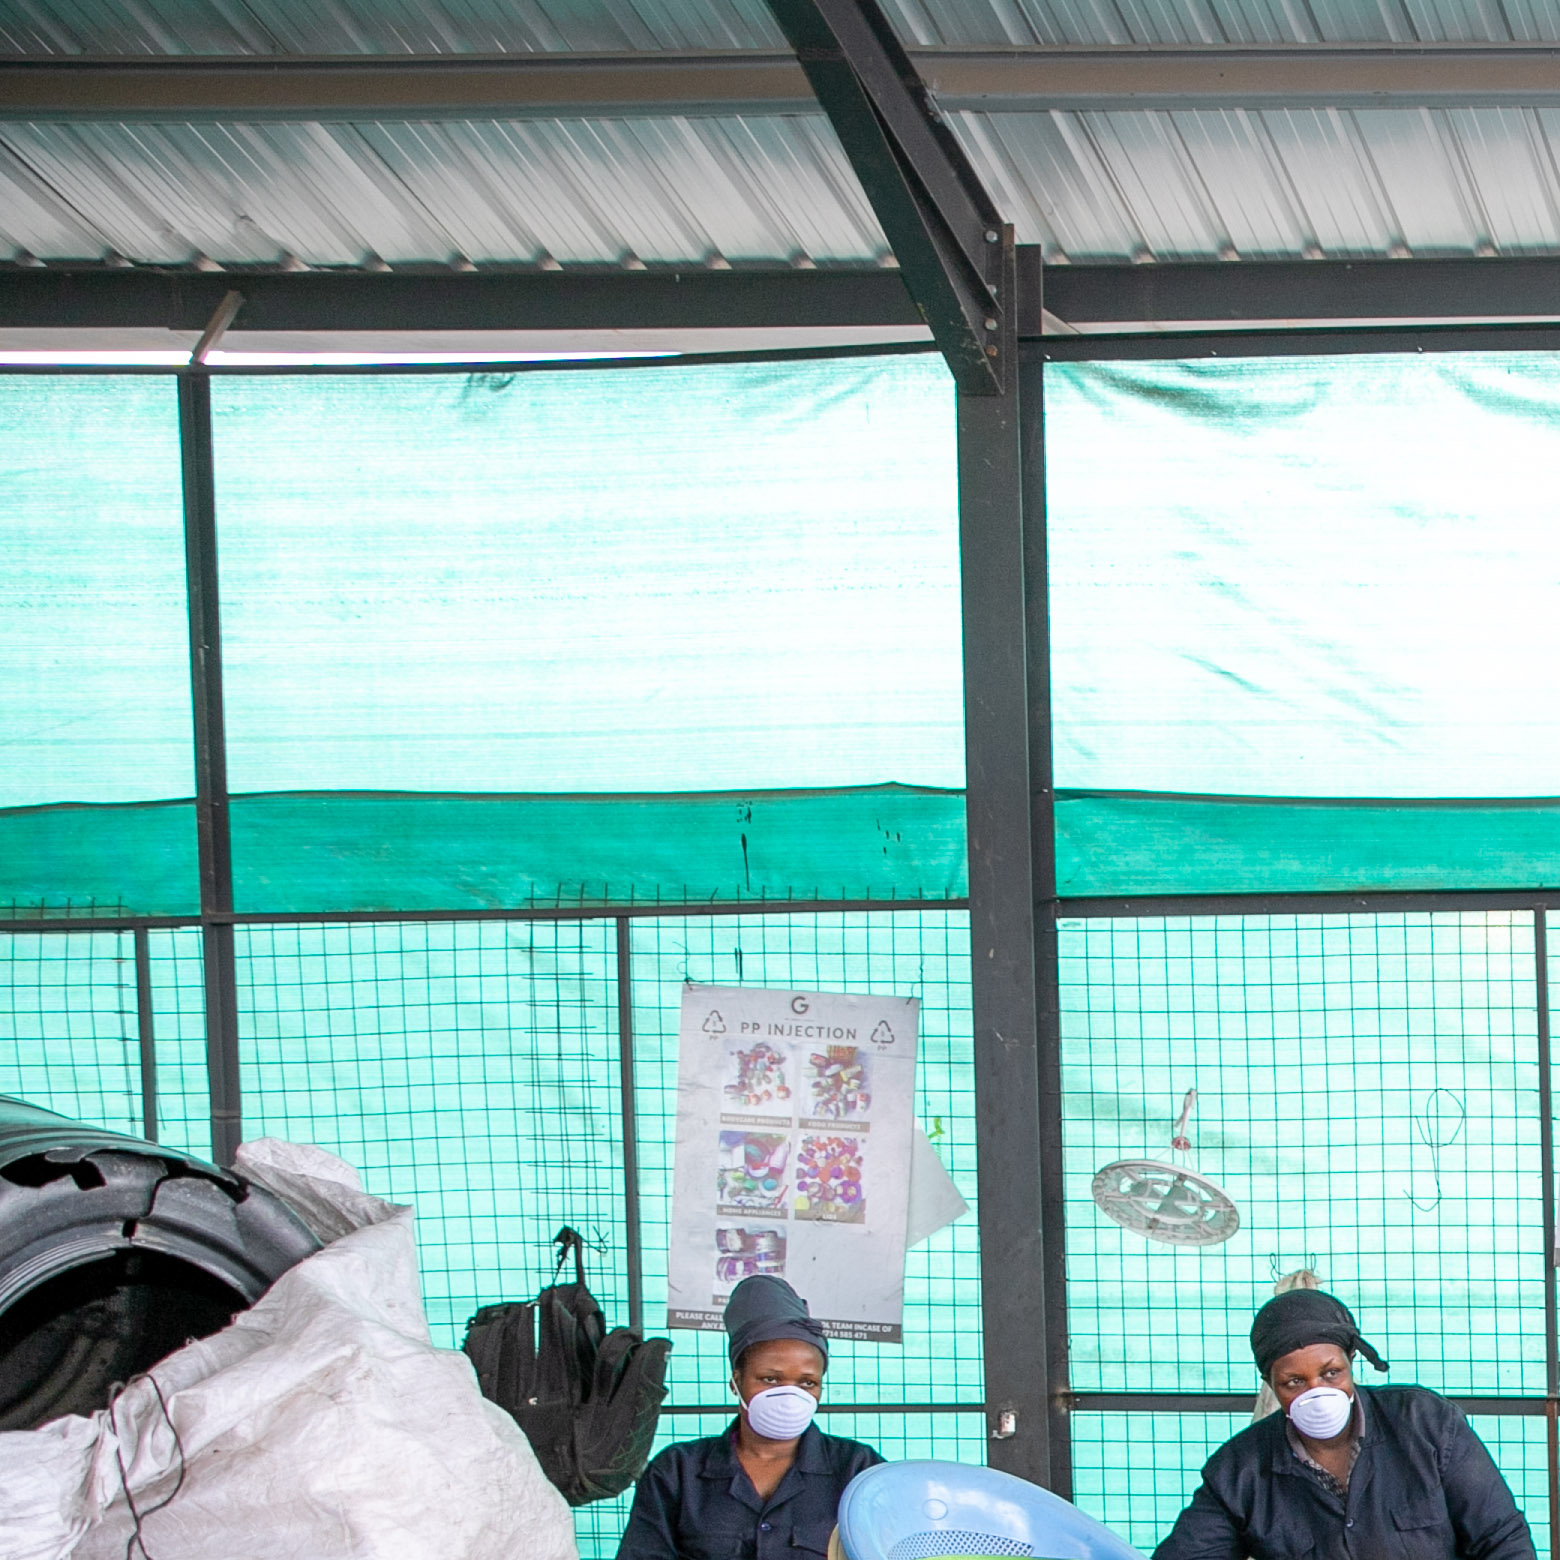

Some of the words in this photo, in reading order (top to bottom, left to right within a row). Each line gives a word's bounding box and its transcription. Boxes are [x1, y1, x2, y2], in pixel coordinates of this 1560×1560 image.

[790, 995, 809, 1015] G
[740, 1021, 761, 1034] PP
[767, 1023, 857, 1040] INJECTION
[675, 1312, 703, 1321] PLEASE
[832, 1322, 854, 1331] TEAM
[855, 1323, 883, 1332] INCASE
[883, 1325, 892, 1333] OF
